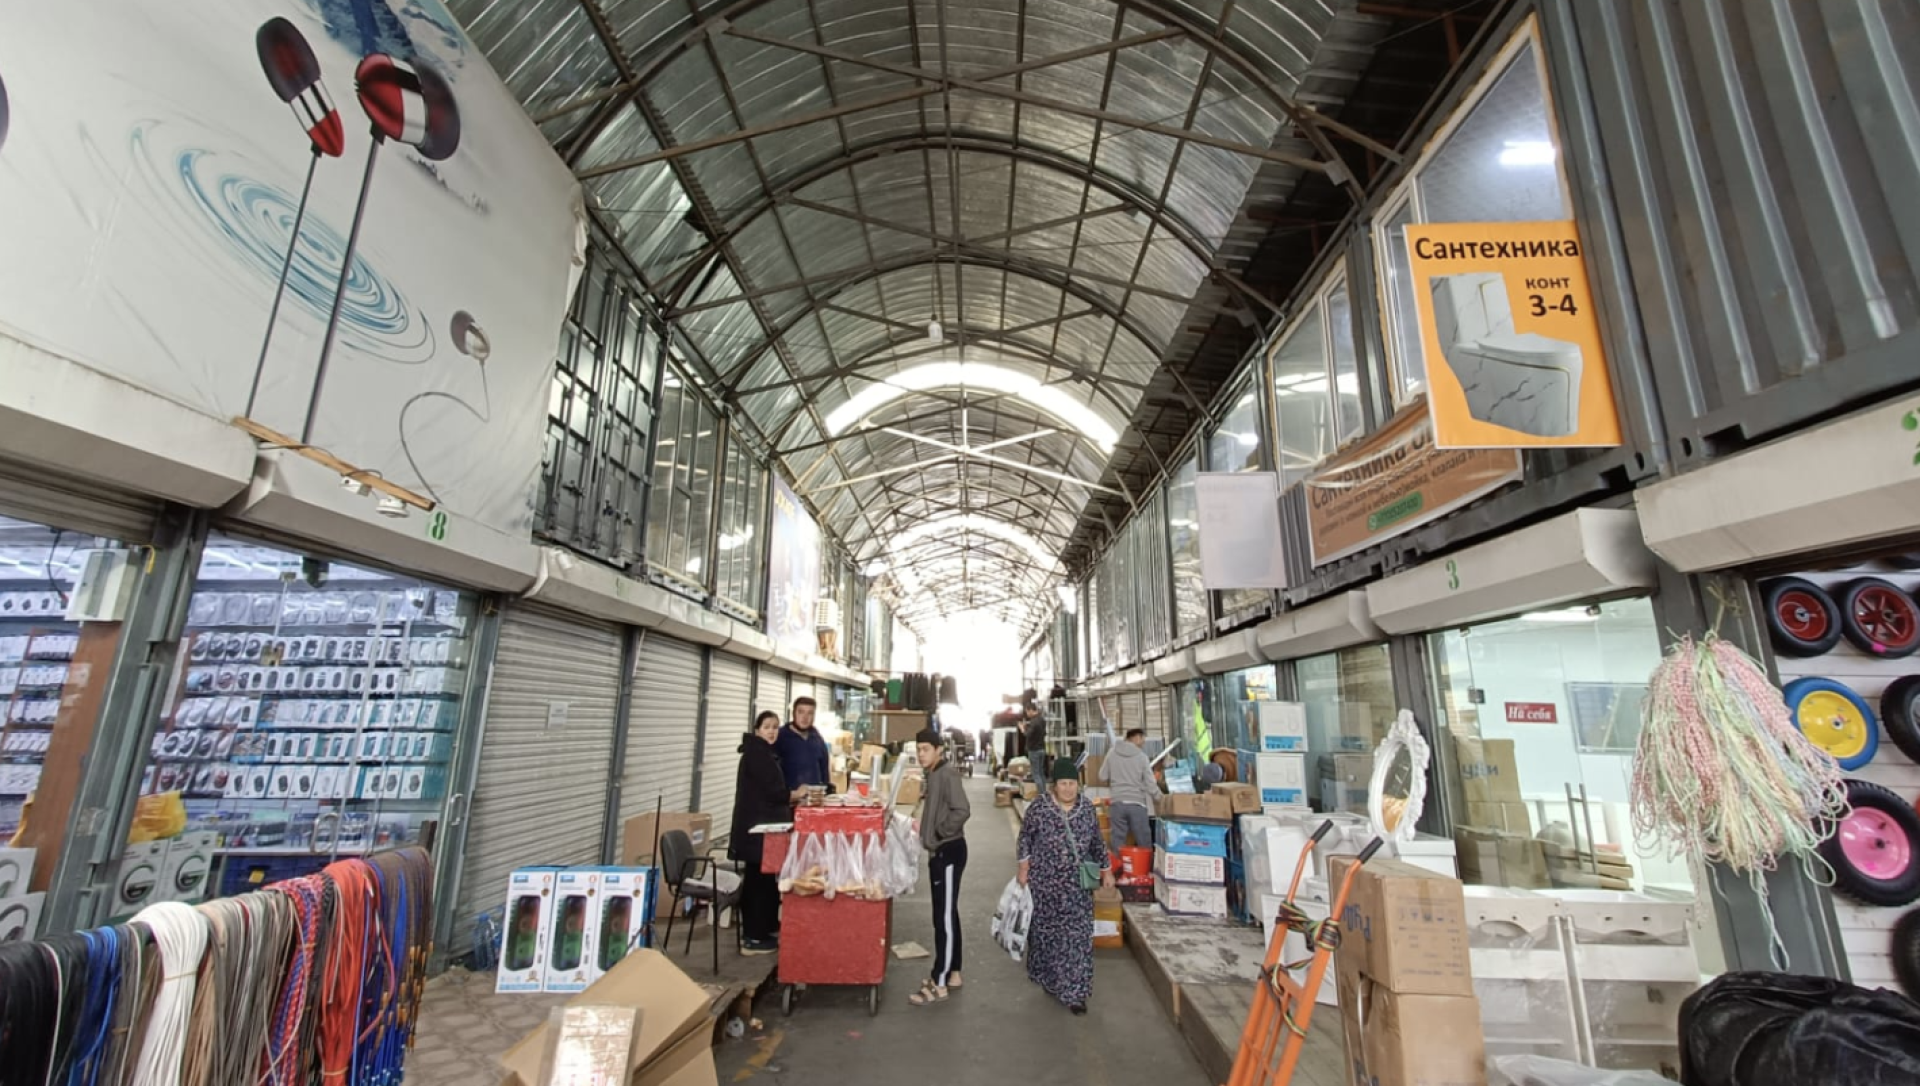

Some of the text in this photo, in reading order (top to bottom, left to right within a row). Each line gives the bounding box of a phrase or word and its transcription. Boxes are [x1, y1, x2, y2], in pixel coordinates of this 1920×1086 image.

[1415, 238, 1579, 260] Сантехника
[1525, 277, 1570, 289] конт
[1529, 295, 1577, 317] 3-4
[432, 511, 446, 540] 8
[1446, 560, 1459, 590] 3
